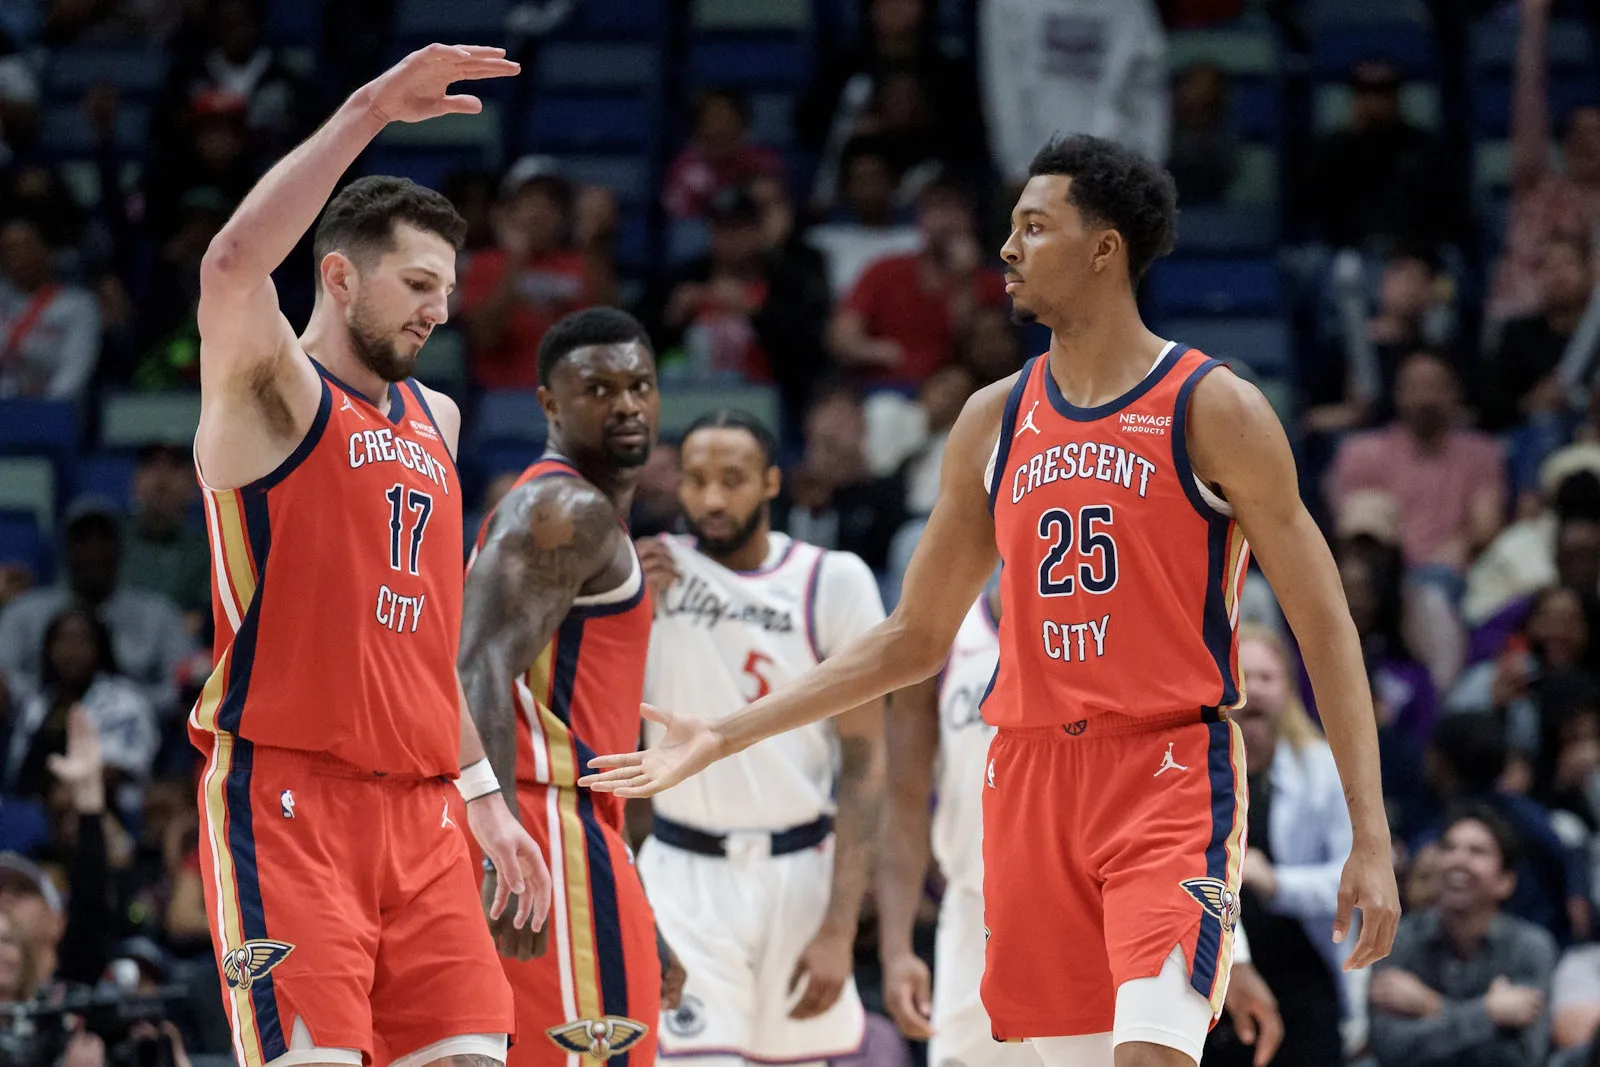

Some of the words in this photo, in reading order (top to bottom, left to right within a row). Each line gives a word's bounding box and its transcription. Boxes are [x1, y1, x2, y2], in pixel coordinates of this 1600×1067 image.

[1119, 413, 1172, 427] NEWAGE
[1122, 425, 1165, 435] PRODUCTS
[1012, 441, 1156, 504] CRESCENT
[385, 482, 433, 576] 17
[1037, 504, 1119, 598] 25
[375, 584, 425, 633] CITY
[1042, 613, 1111, 662] CITY
[742, 650, 776, 704] 5
